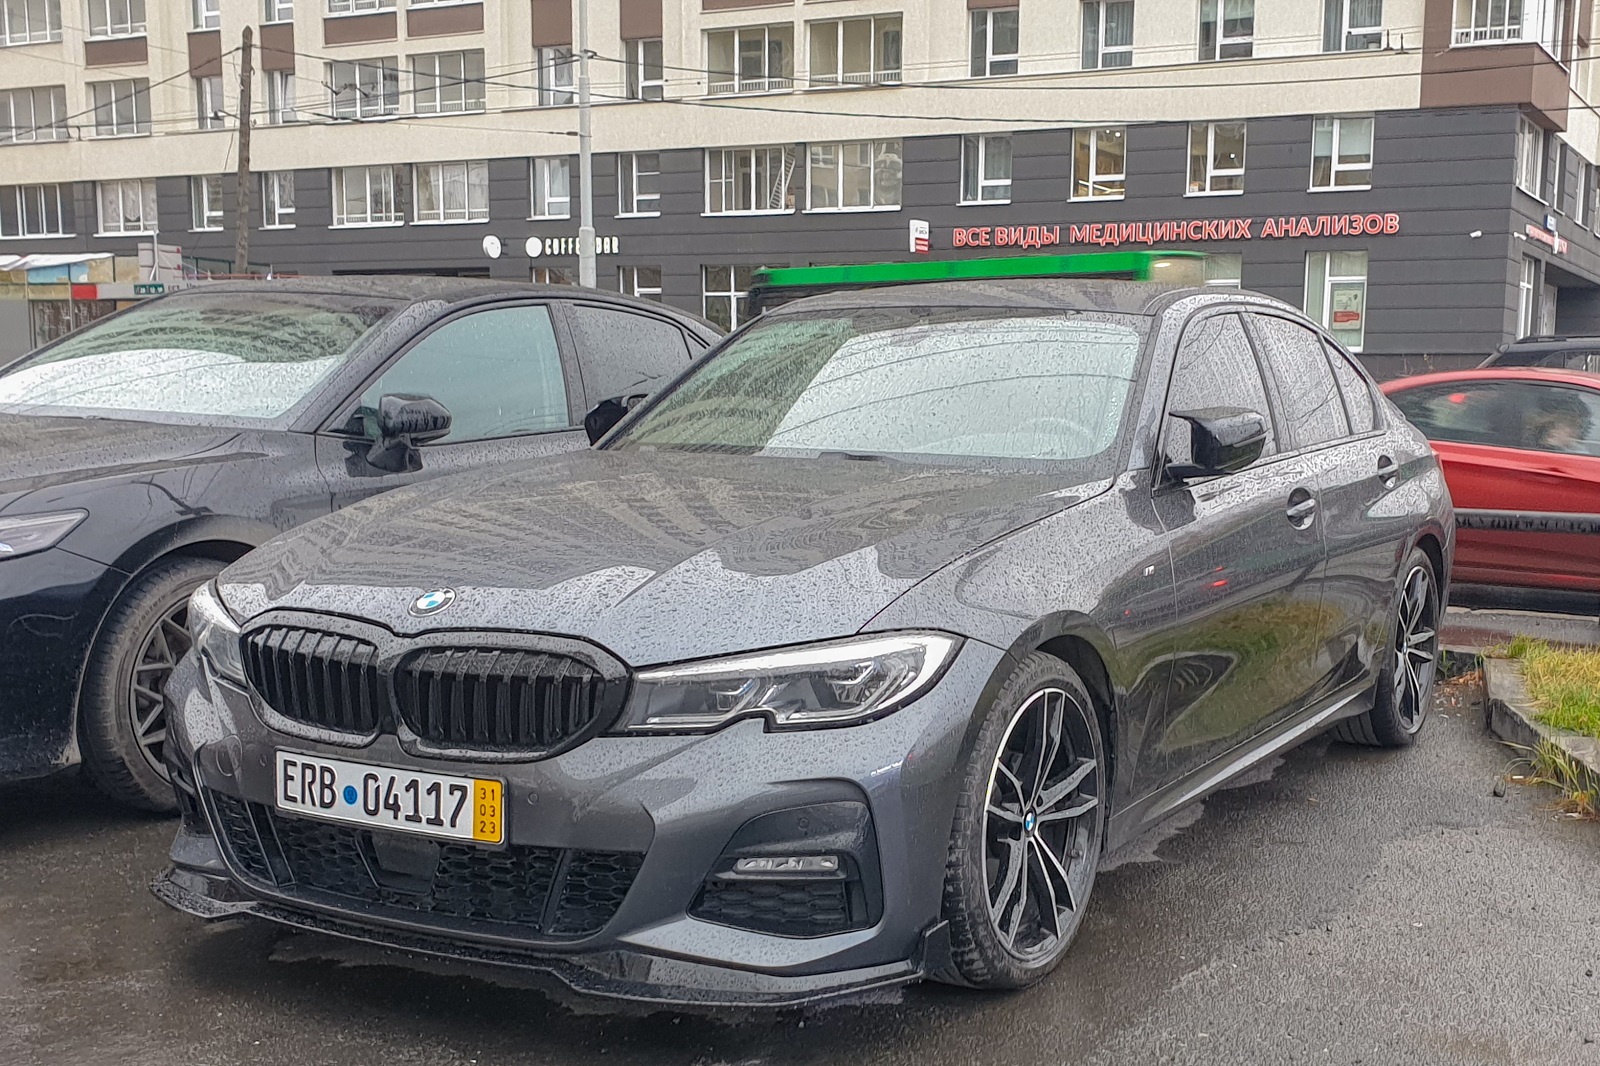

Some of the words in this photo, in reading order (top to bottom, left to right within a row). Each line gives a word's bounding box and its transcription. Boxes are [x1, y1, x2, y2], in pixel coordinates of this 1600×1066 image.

[952, 227, 991, 247] ВСЕ
[994, 225, 1060, 249] ВИДЫ
[1069, 218, 1252, 247] МЕДИЦИНСКИХ
[1260, 213, 1400, 238] АНАЛИЗОВ
[544, 237, 581, 256] COFFE
[283, 759, 338, 809] ERB
[363, 772, 469, 828] 04117
[480, 787, 496, 801] 31
[480, 804, 496, 817] 03
[479, 820, 496, 834] 23
